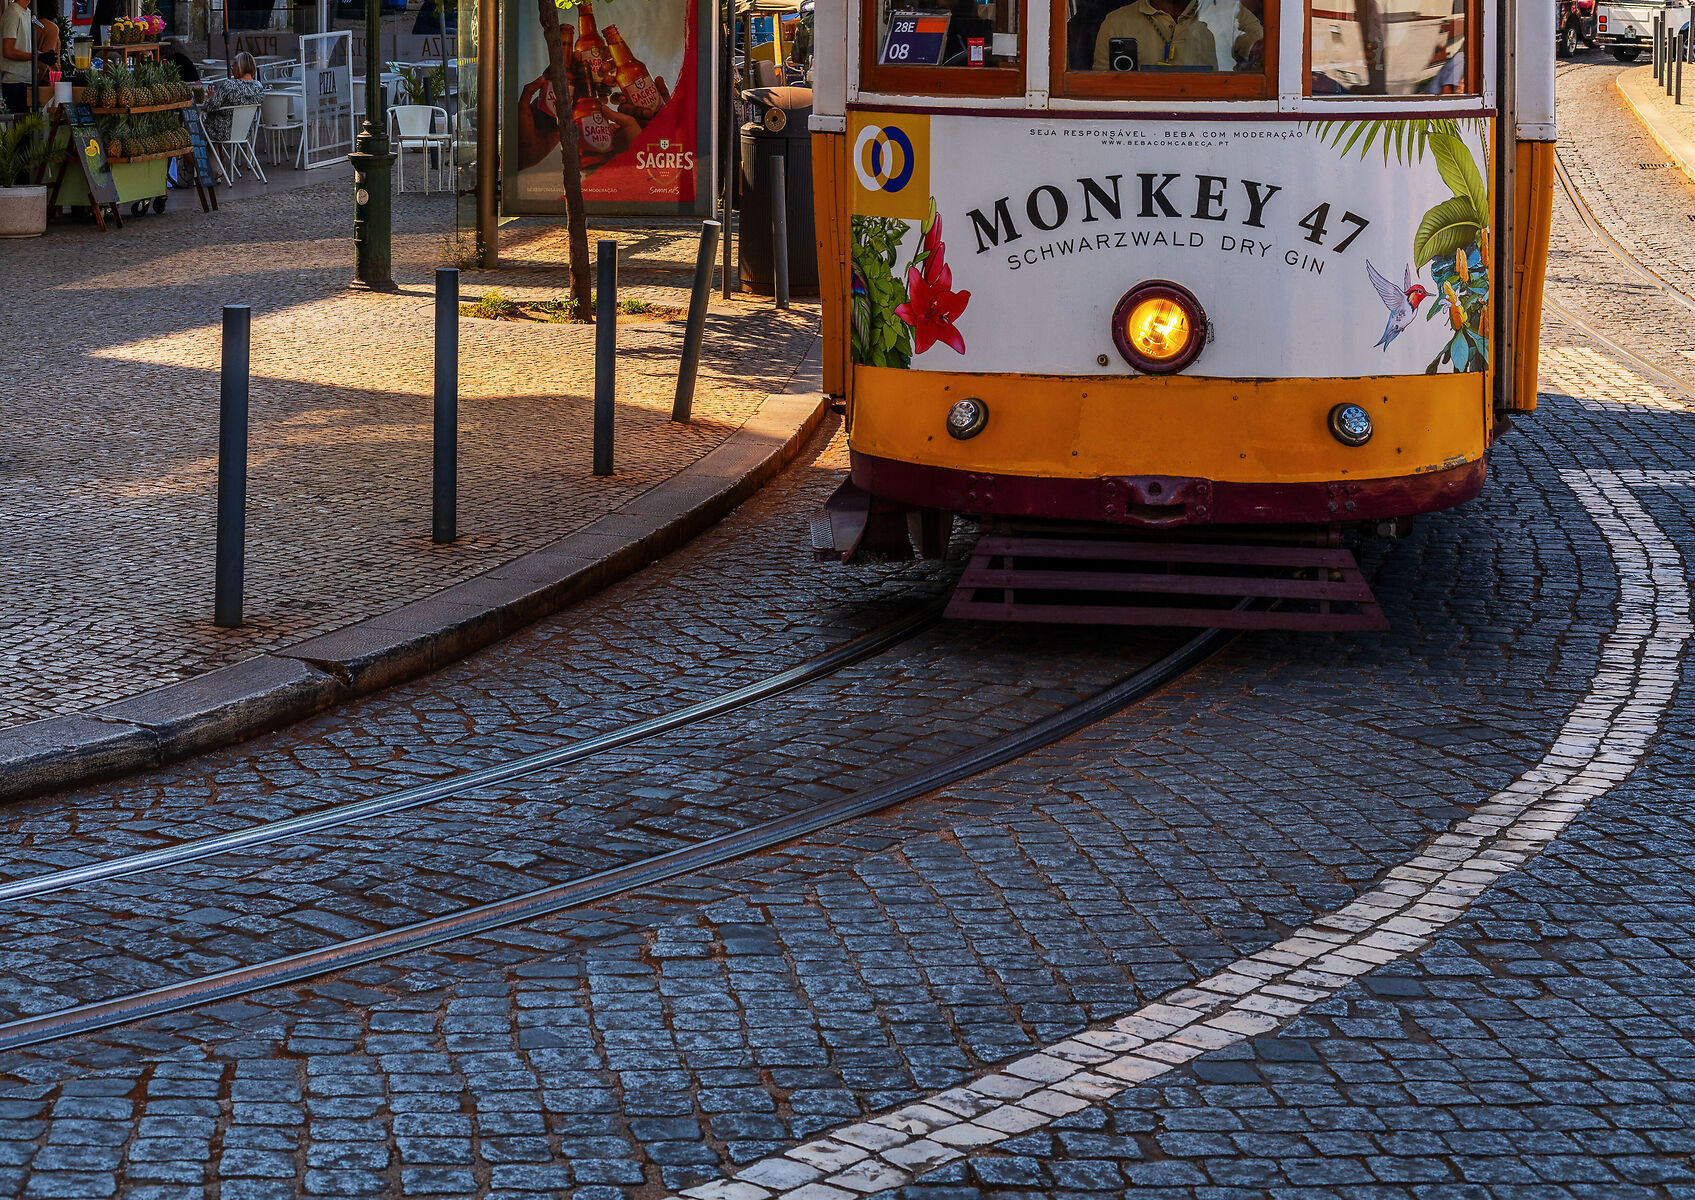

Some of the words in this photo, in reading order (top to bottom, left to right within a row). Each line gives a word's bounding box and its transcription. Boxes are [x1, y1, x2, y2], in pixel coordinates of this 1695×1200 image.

[894, 21, 915, 33] 28E
[888, 43, 910, 60] 08
[319, 70, 337, 96] PIZZA
[632, 84, 657, 103] SAGRES
[1029, 128, 1057, 136] SEJA
[1063, 128, 1146, 138] RESPONSÁVEL
[1233, 129, 1303, 140] MODERAÇÃO
[636, 151, 694, 170] SAGRES
[966, 173, 1282, 255] MONKEY
[1298, 202, 1370, 254] 47
[1008, 230, 1204, 270] SCHWARZWALD
[1222, 235, 1273, 258] DRY
[1285, 250, 1325, 275] GIN
